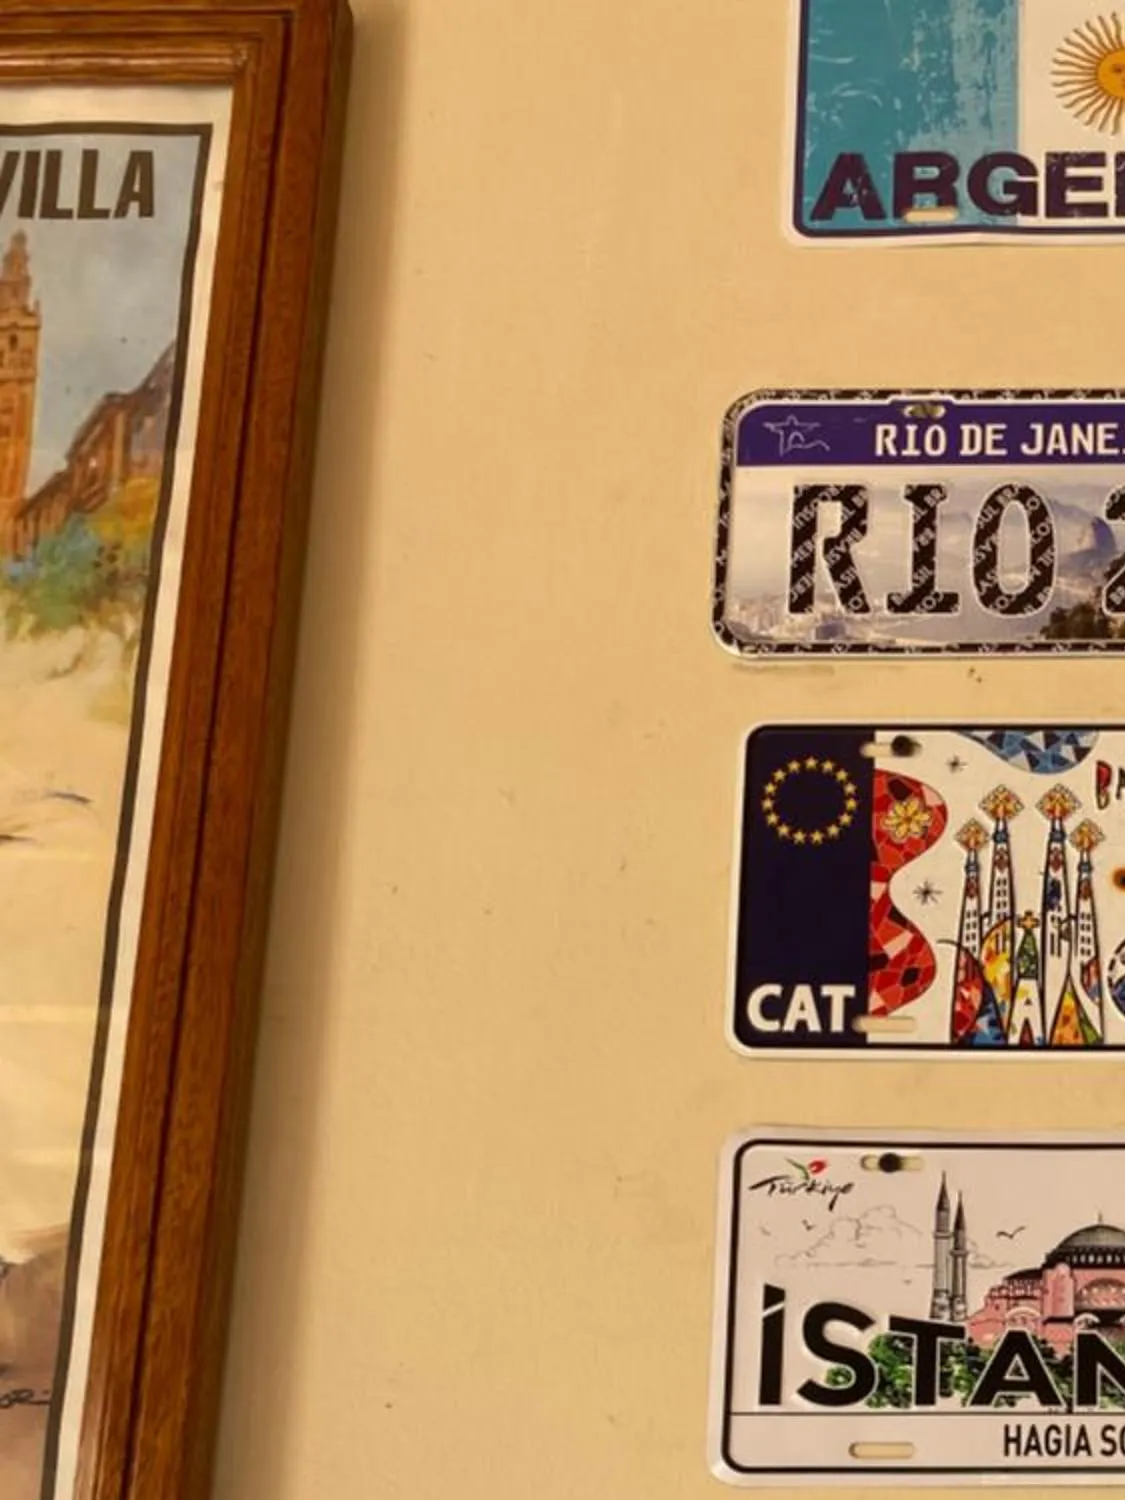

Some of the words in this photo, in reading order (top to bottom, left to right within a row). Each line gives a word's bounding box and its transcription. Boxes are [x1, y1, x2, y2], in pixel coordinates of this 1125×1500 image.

[875, 423, 947, 457] RIO
[959, 423, 1008, 456] DE
[787, 483, 1057, 617] RIO
[746, 984, 856, 1033] CAT
[1002, 1424, 1093, 1459] HAGIA
